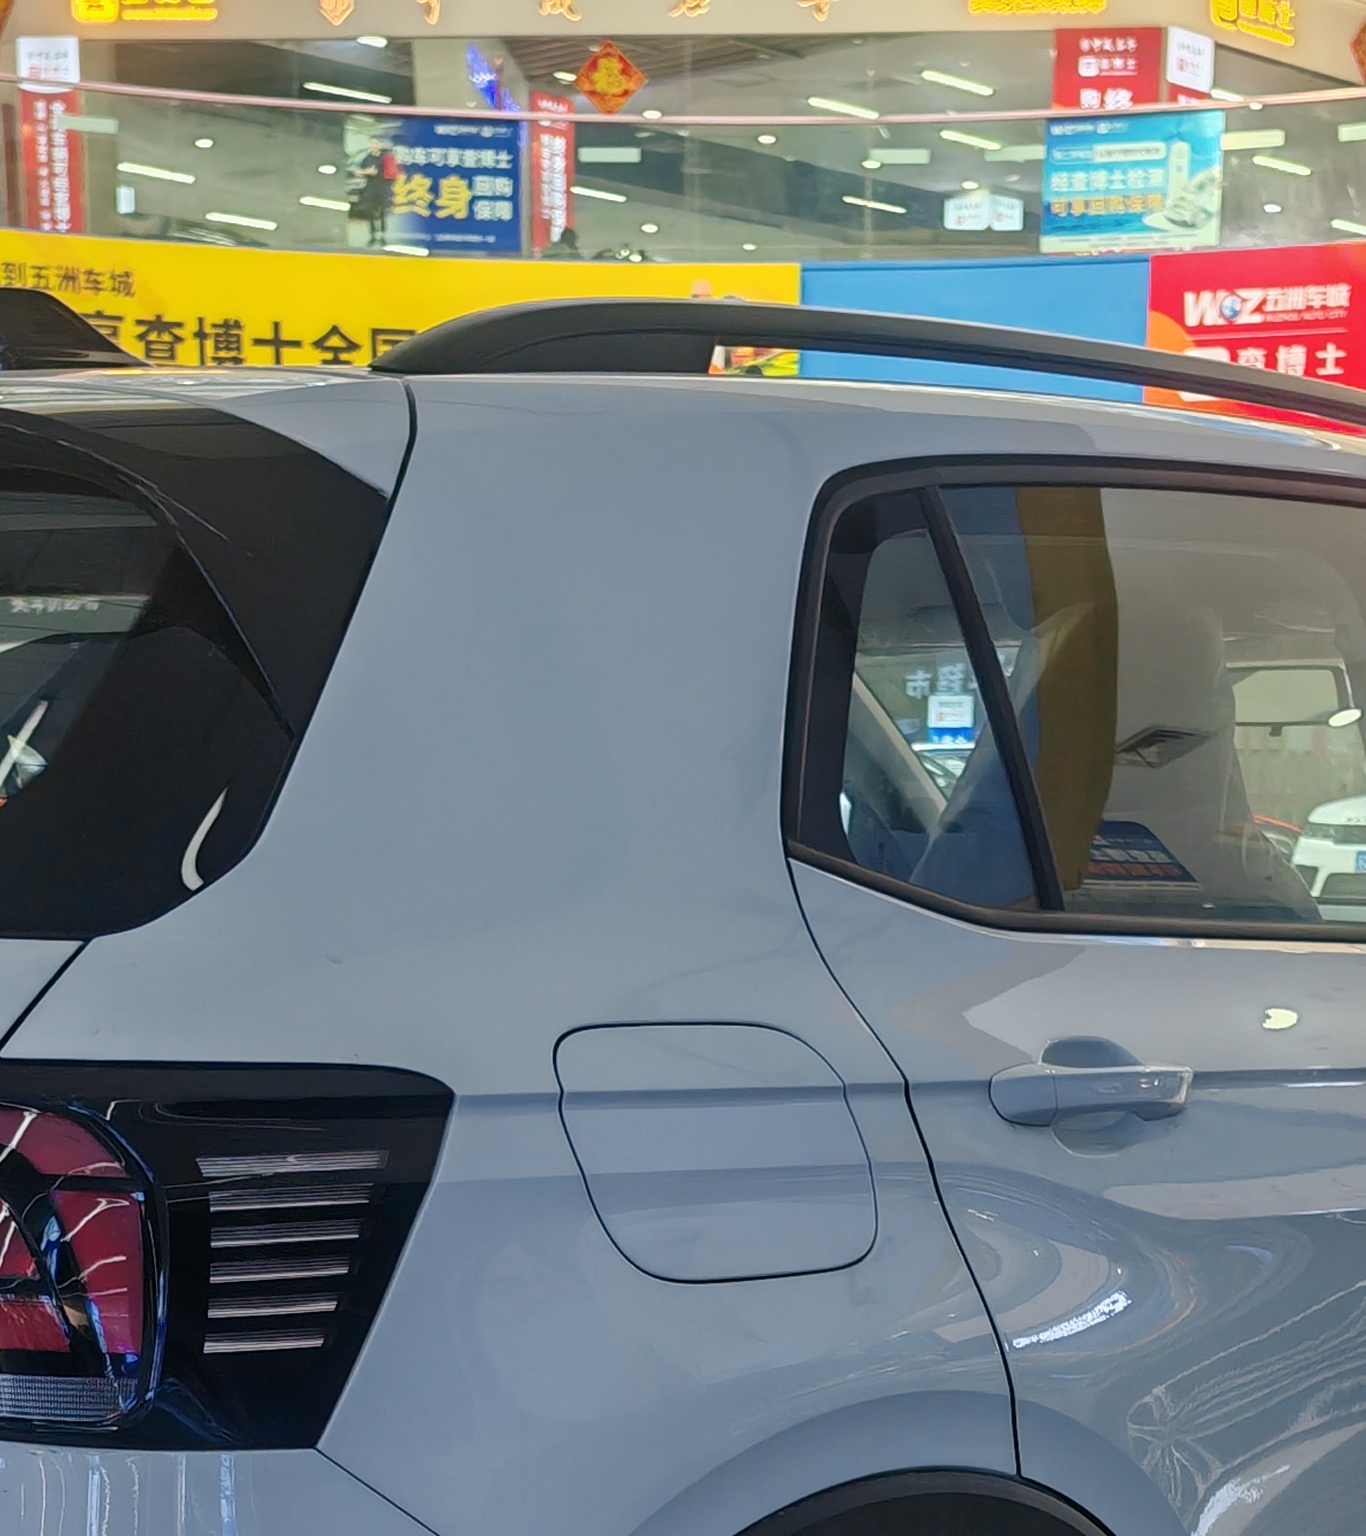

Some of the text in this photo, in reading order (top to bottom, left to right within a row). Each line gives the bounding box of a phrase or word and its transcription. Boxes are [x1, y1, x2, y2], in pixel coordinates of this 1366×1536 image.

[392, 173, 472, 220] 终身
[1237, 342, 1348, 377] 查博士
